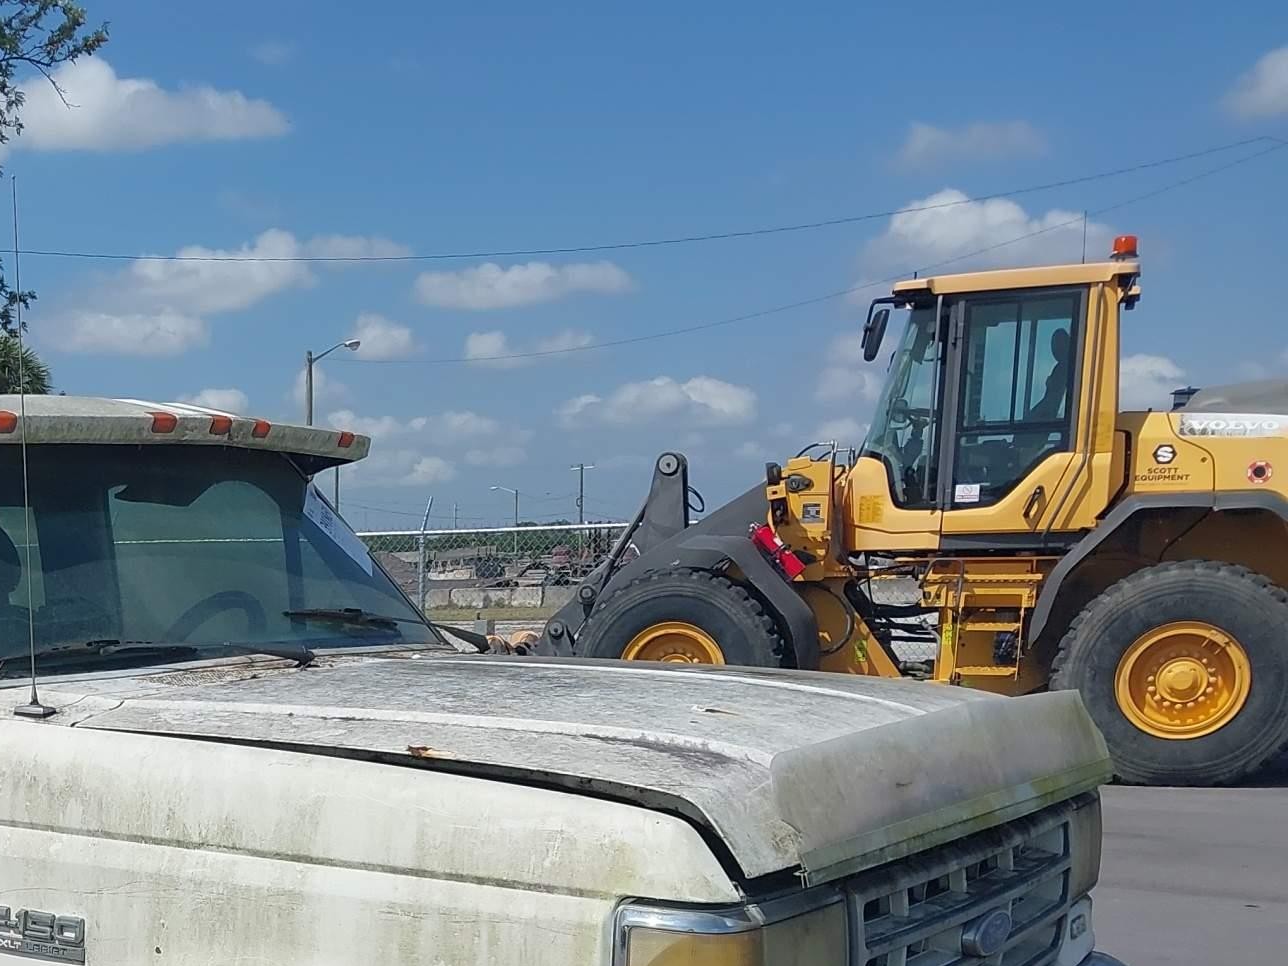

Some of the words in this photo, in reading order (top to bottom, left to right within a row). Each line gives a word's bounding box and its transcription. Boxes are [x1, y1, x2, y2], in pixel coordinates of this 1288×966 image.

[1188, 419, 1280, 430] VOLVO
[1135, 474, 1190, 482] EQUIPMENT
[0, 938, 22, 949] XLT
